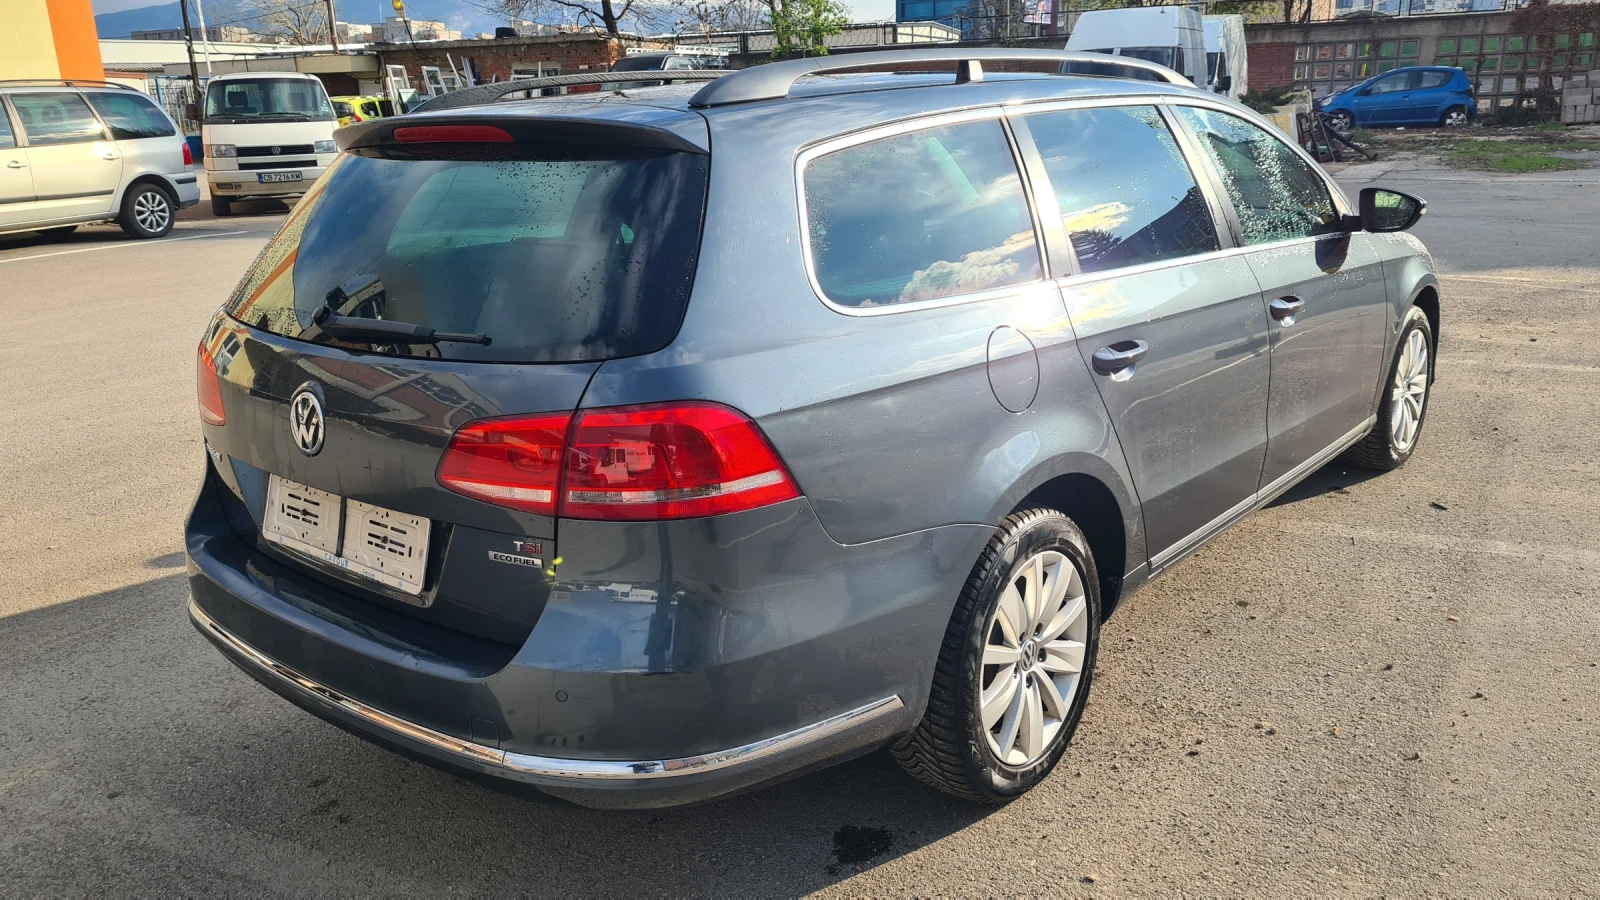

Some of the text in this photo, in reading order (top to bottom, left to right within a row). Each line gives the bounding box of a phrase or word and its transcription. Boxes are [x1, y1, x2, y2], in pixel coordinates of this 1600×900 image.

[263, 172, 301, 182] CB 7216 KM
[513, 540, 543, 555] TSI
[324, 552, 349, 567] CAVOUR
